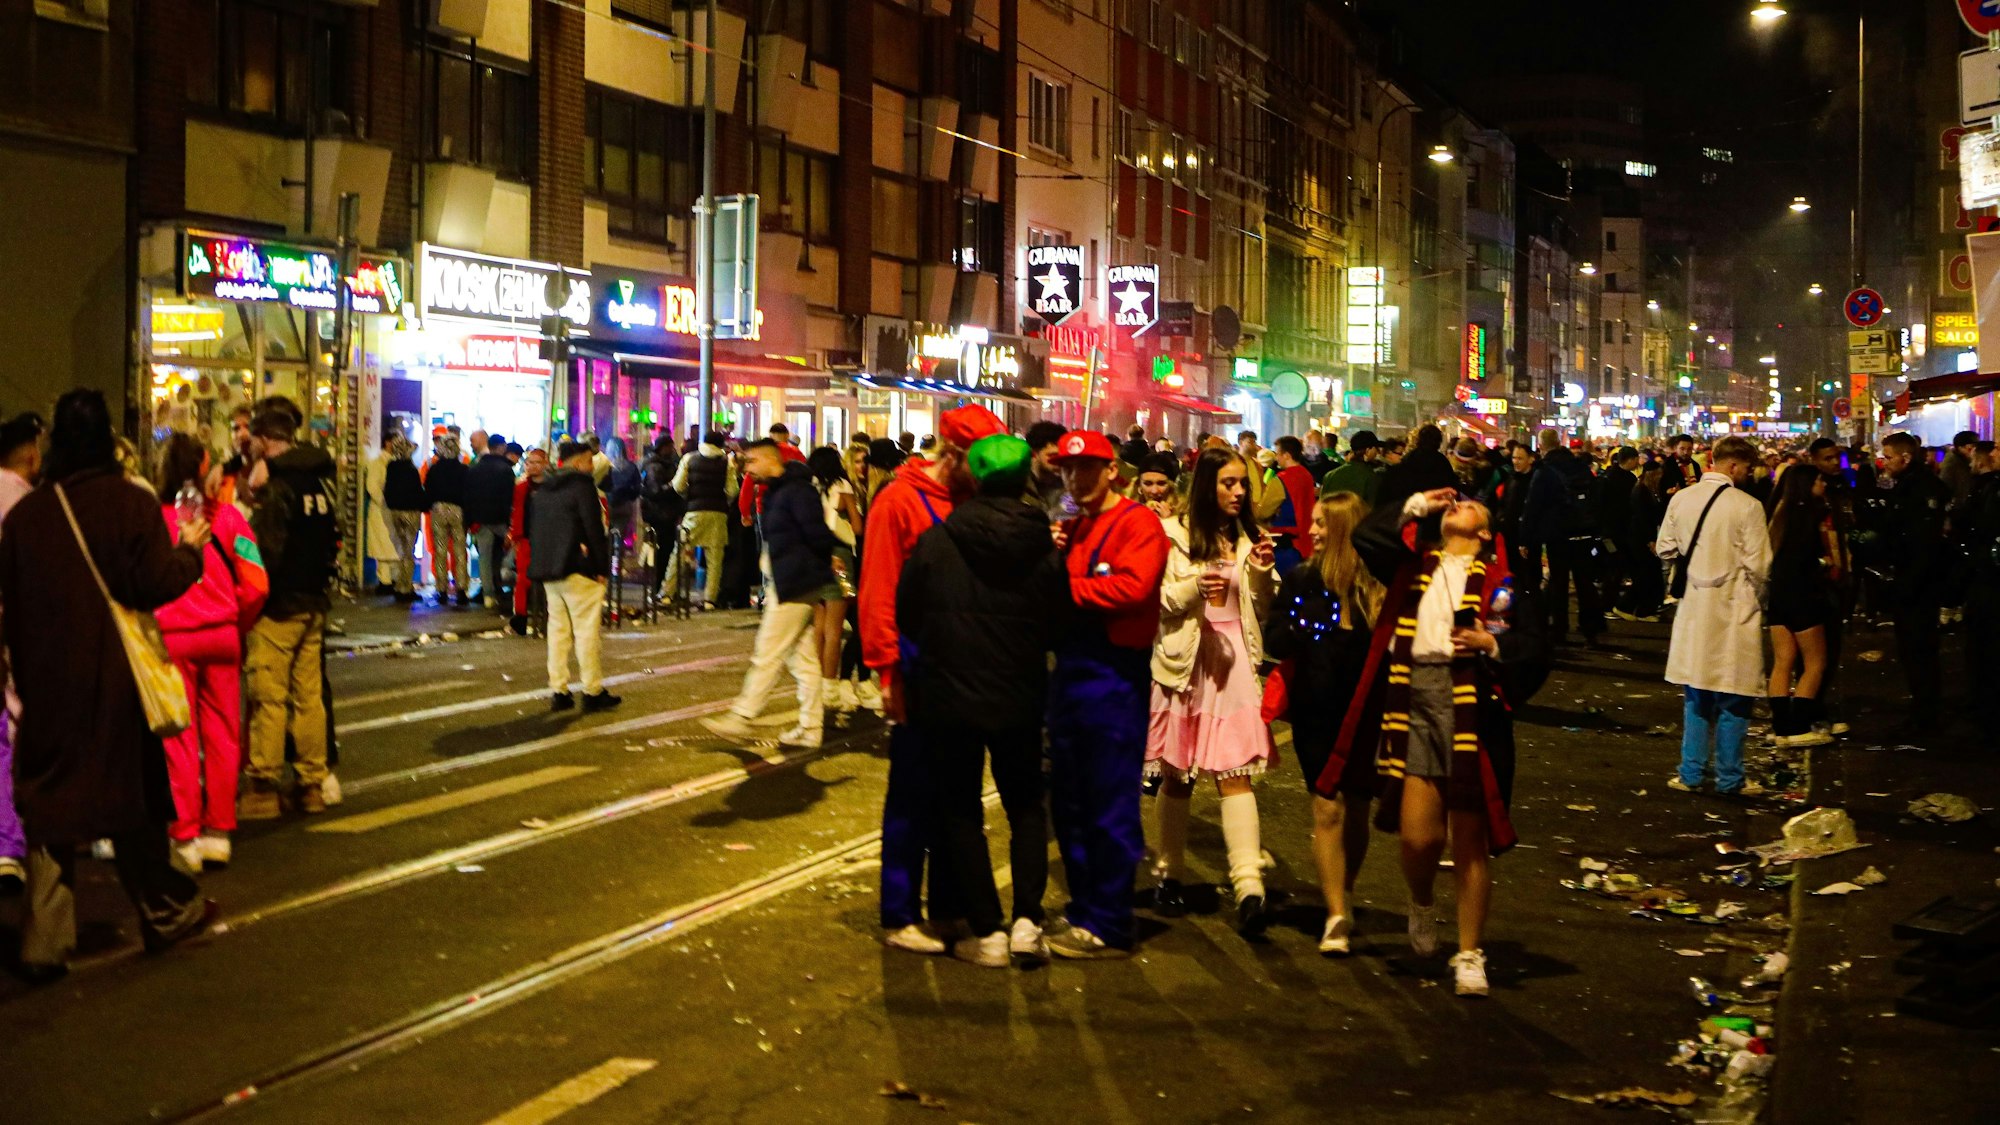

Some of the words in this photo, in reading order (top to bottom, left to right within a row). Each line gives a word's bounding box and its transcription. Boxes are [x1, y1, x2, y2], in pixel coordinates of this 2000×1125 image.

[1029, 246, 1080, 266] CUBANA
[1108, 265, 1156, 284] CUBANA
[429, 256, 501, 315] KIOSK
[1035, 298, 1073, 313] BAR
[1114, 312, 1150, 326] BAR
[1935, 315, 1976, 327] SPIEL
[1935, 330, 1978, 343] SALO
[1468, 323, 1479, 381] RENDEZVOUS
